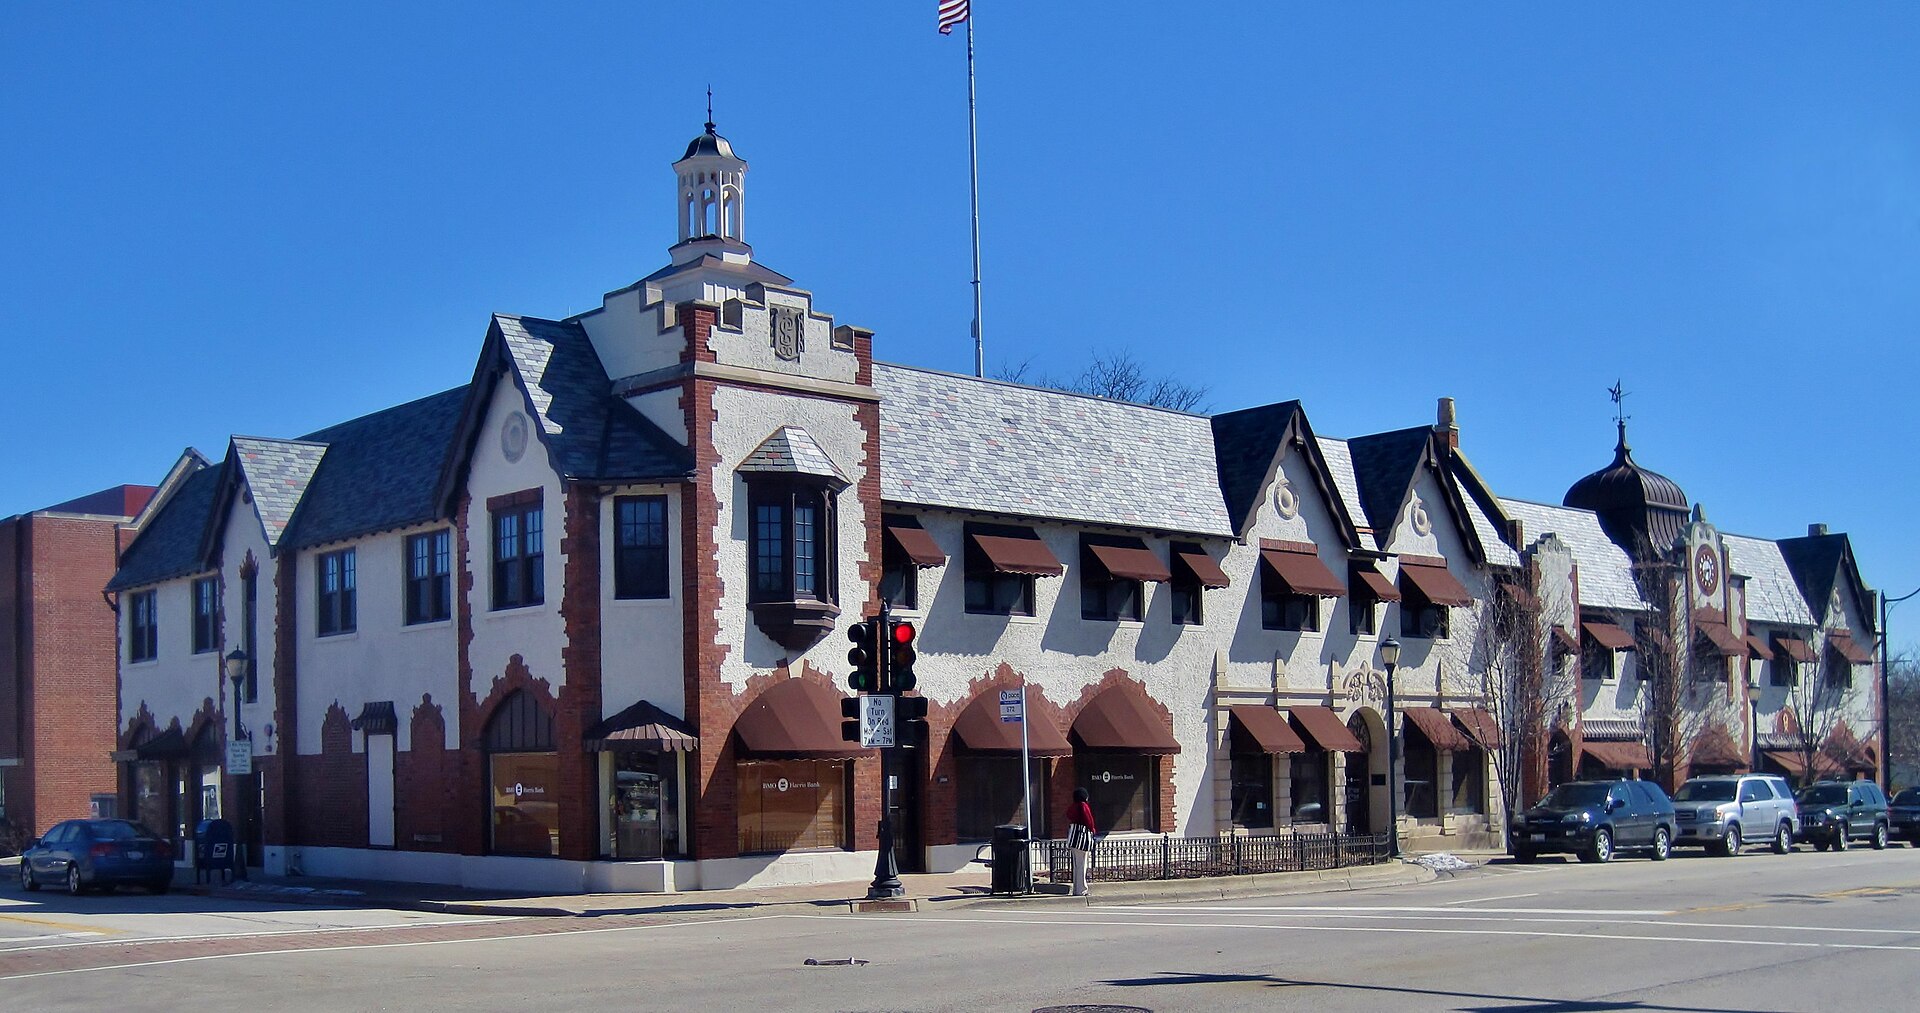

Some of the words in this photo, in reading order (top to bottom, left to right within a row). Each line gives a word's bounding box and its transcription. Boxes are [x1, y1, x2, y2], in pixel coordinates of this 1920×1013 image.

[873, 697, 882, 706] No
[871, 707, 885, 715] Turn
[867, 717, 876, 725] On
[877, 717, 889, 725] Red
[863, 727, 875, 735] Mon
[883, 727, 892, 735] Sat
